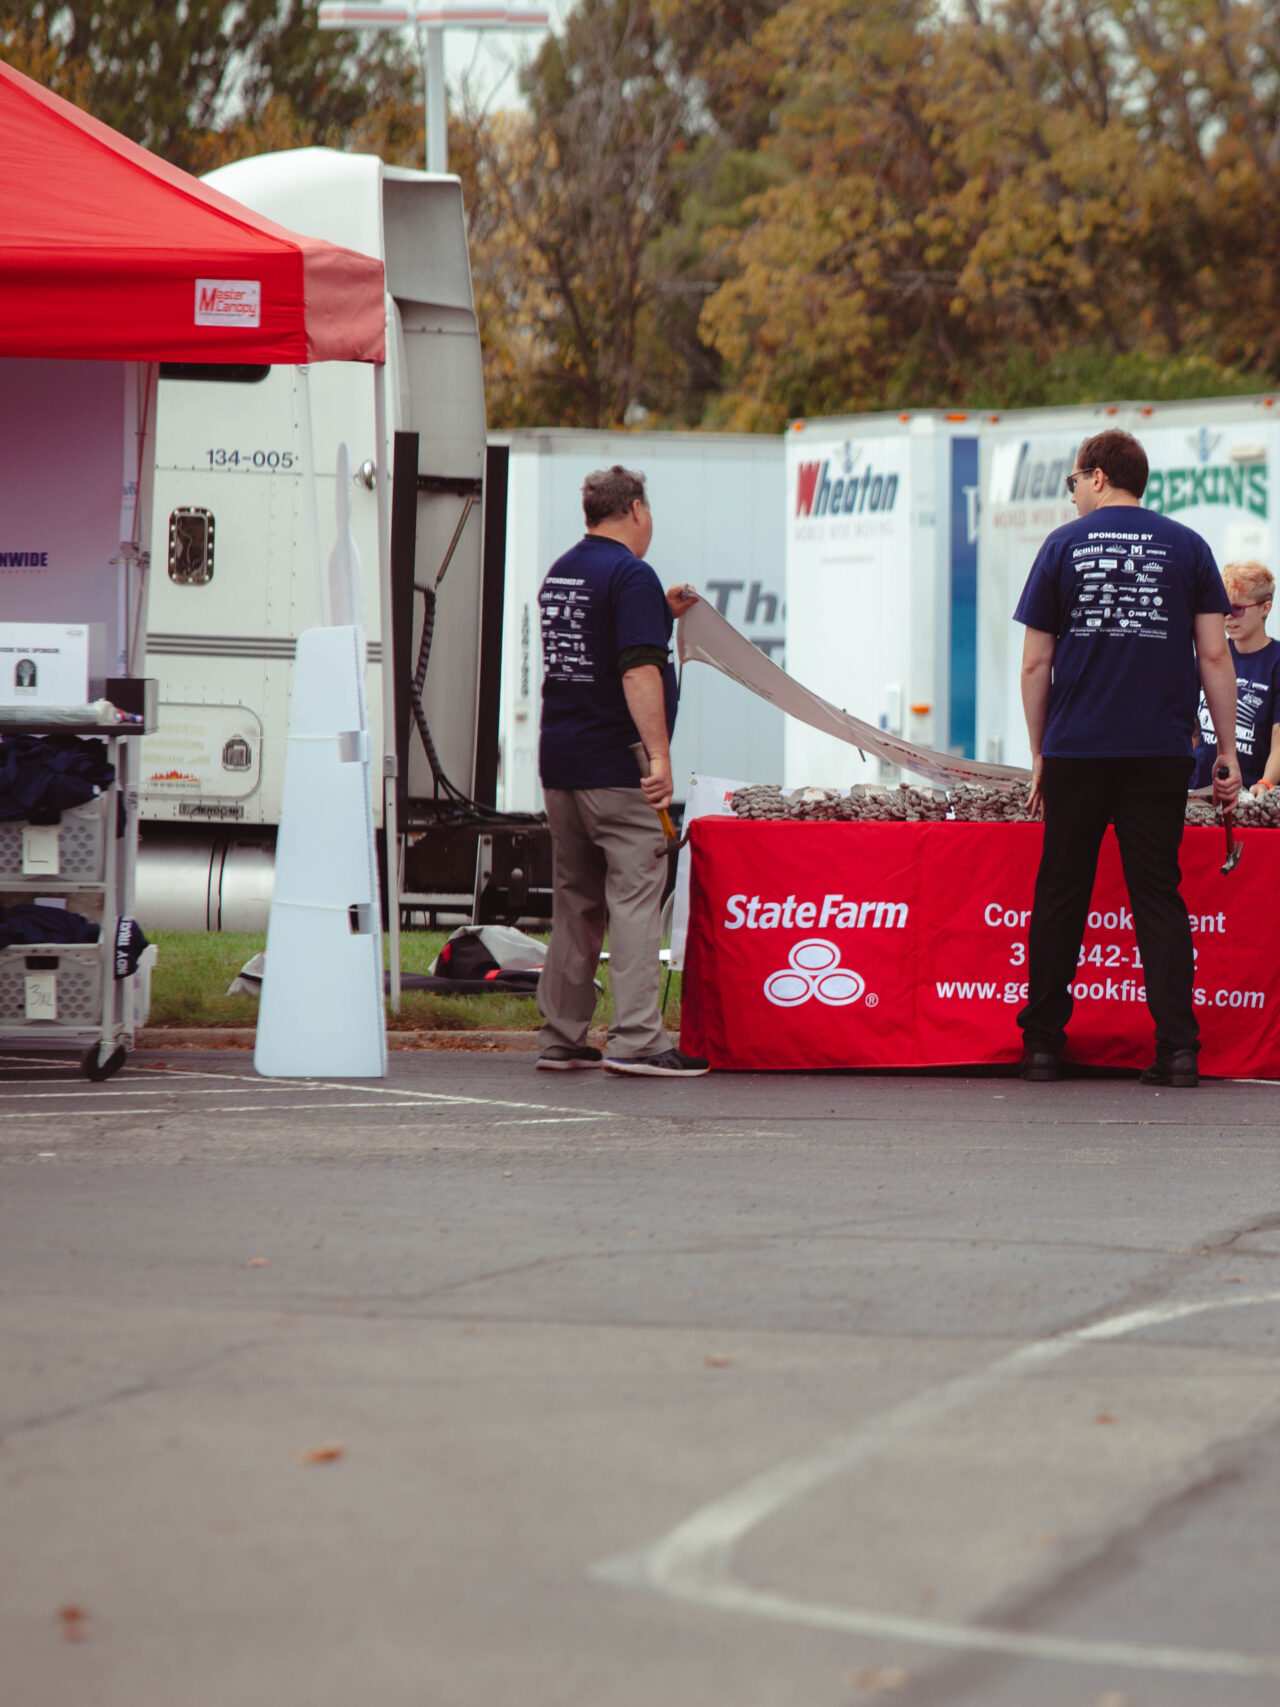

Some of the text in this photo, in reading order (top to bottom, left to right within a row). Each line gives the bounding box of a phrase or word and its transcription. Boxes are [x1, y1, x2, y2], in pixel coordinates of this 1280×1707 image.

[199, 288, 246, 311] Master
[216, 301, 257, 318] Canopy
[206, 448, 294, 469] 134-005
[796, 459, 899, 517] Wheaton
[1146, 462, 1268, 519] BEKINS
[1088, 532, 1139, 540] SPONSORED
